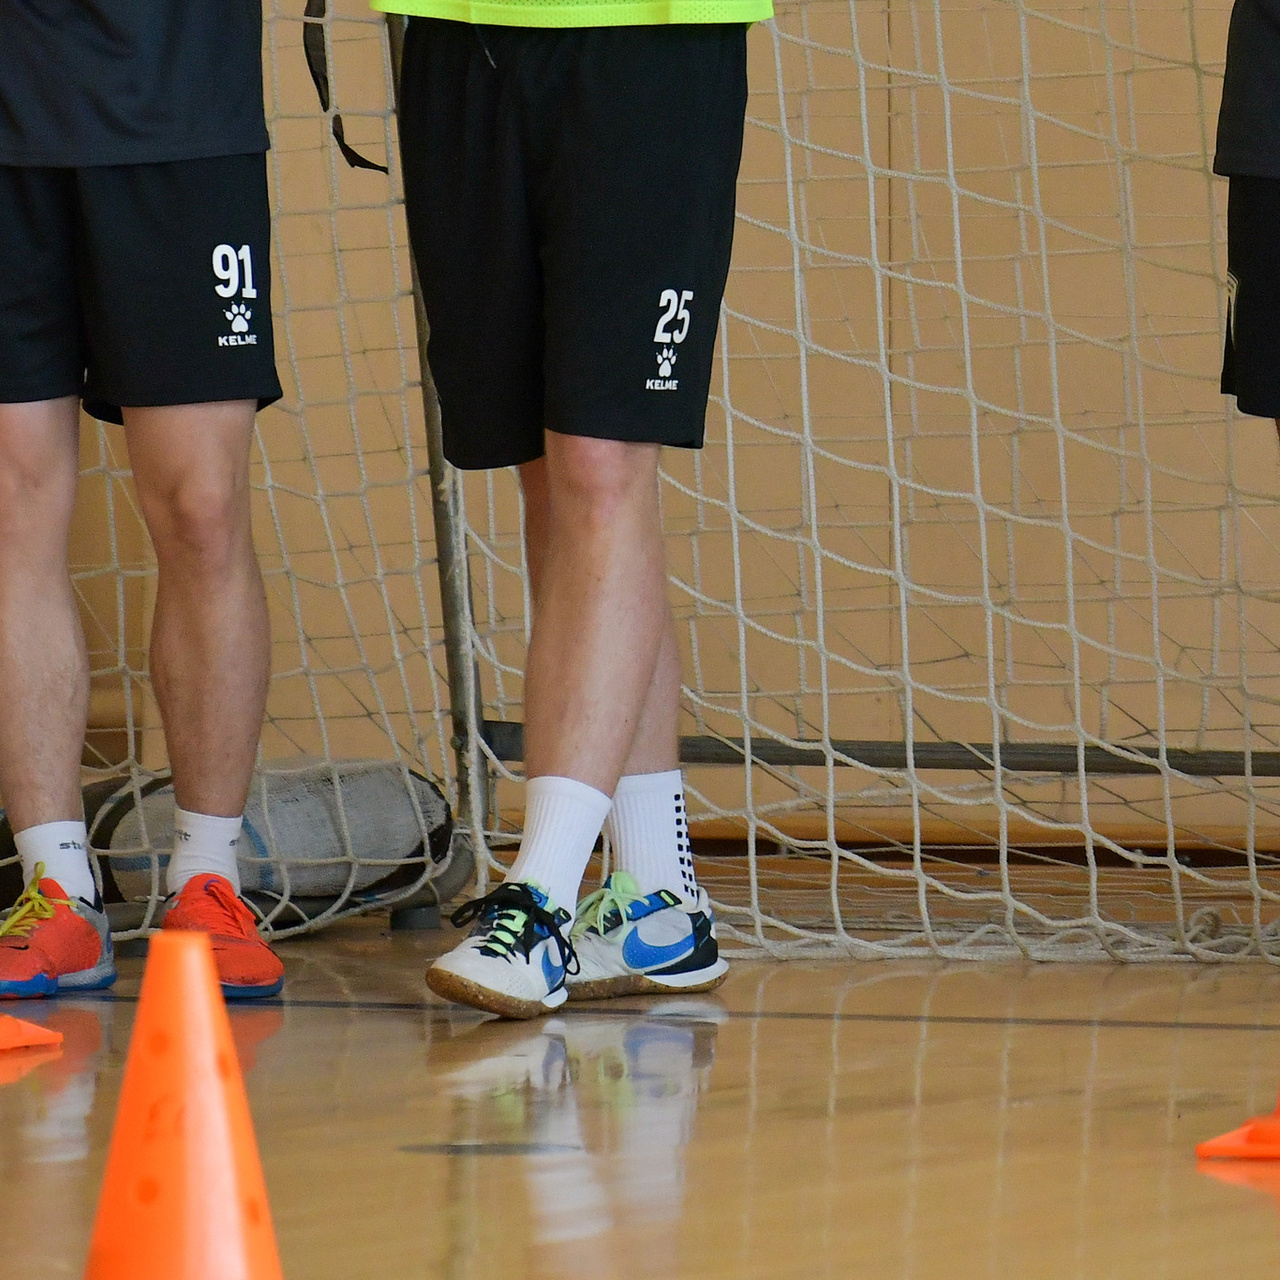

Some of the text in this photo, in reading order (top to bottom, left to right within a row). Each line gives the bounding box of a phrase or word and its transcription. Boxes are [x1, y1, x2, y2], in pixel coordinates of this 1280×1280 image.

[211, 243, 258, 299] 91
[652, 288, 695, 344] 25
[217, 334, 258, 347] KELME
[645, 378, 680, 391] KELME
